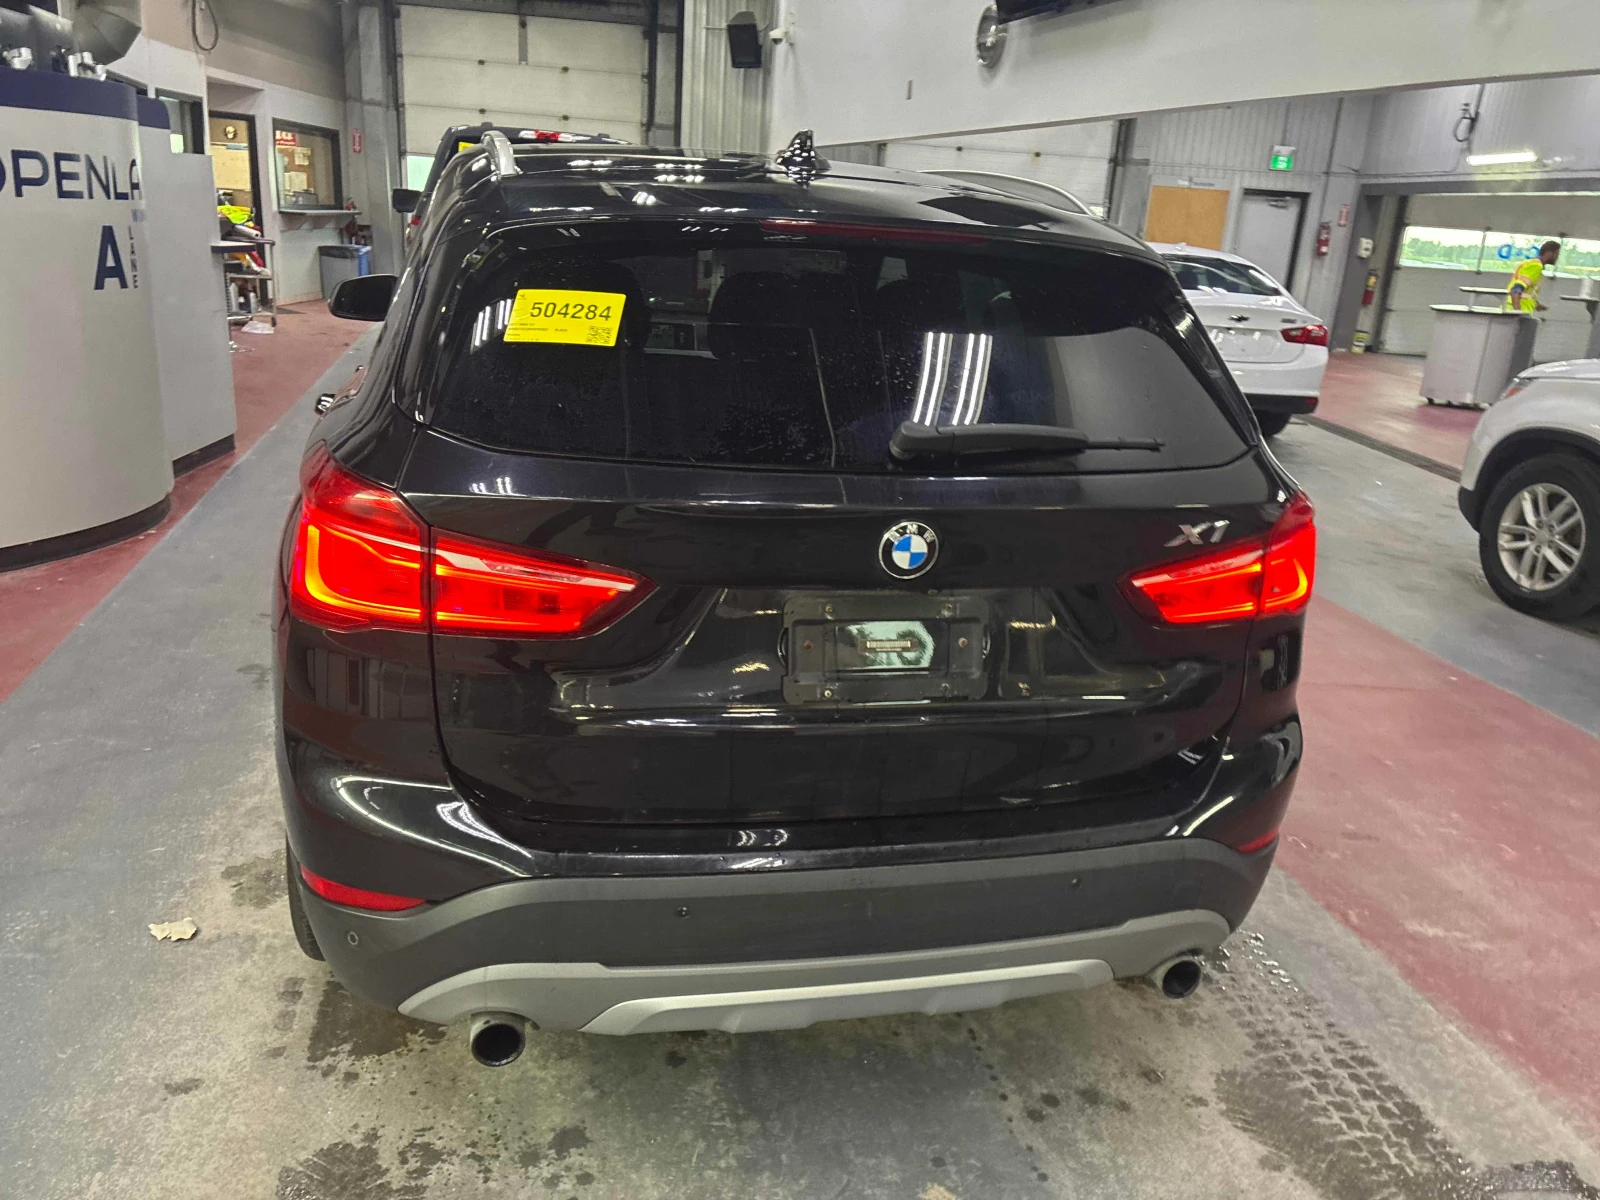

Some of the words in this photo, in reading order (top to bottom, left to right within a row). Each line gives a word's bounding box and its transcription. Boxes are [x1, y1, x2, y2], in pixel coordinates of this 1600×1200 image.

[94, 225, 129, 290] A
[128, 225, 139, 289] LANE
[530, 302, 612, 321] 504284
[888, 523, 935, 544] BMW
[1164, 520, 1230, 547] X1
